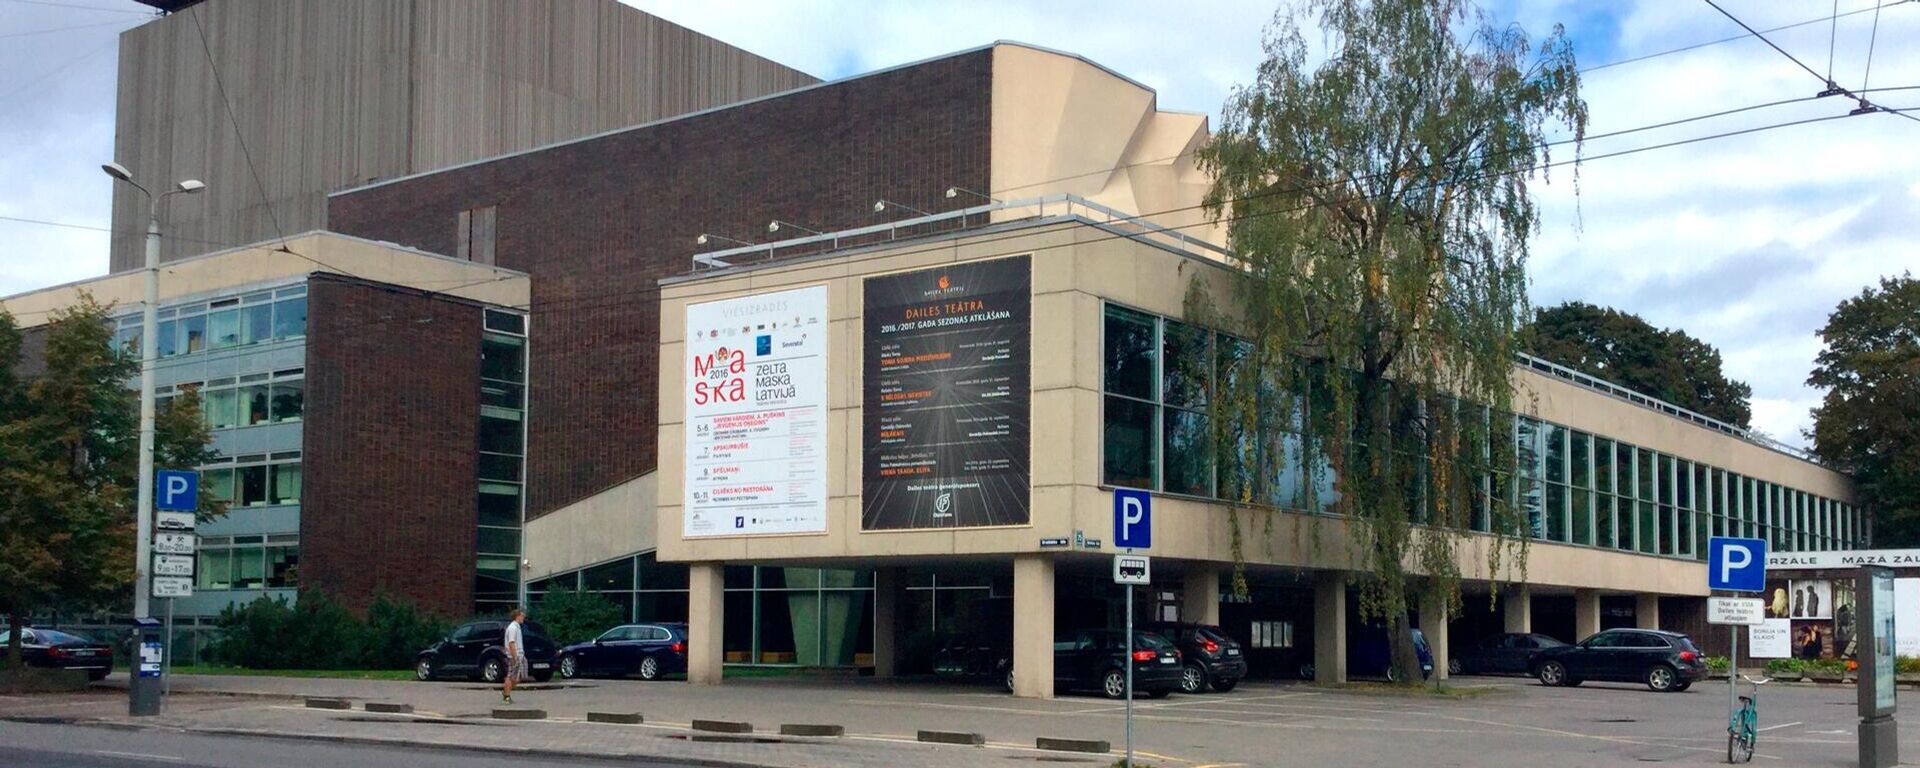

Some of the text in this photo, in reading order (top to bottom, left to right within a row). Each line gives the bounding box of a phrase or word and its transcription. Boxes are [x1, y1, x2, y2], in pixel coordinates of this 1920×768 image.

[906, 301, 984, 319] DAILES TEĀTRA
[918, 319, 936, 329] GADA
[937, 315, 968, 327] SEZONAS
[970, 310, 1010, 322] ATKLĀŠANA
[710, 368, 728, 380] 2016
[166, 476, 188, 505] P
[1123, 496, 1143, 540] P
[1721, 544, 1752, 583] P
